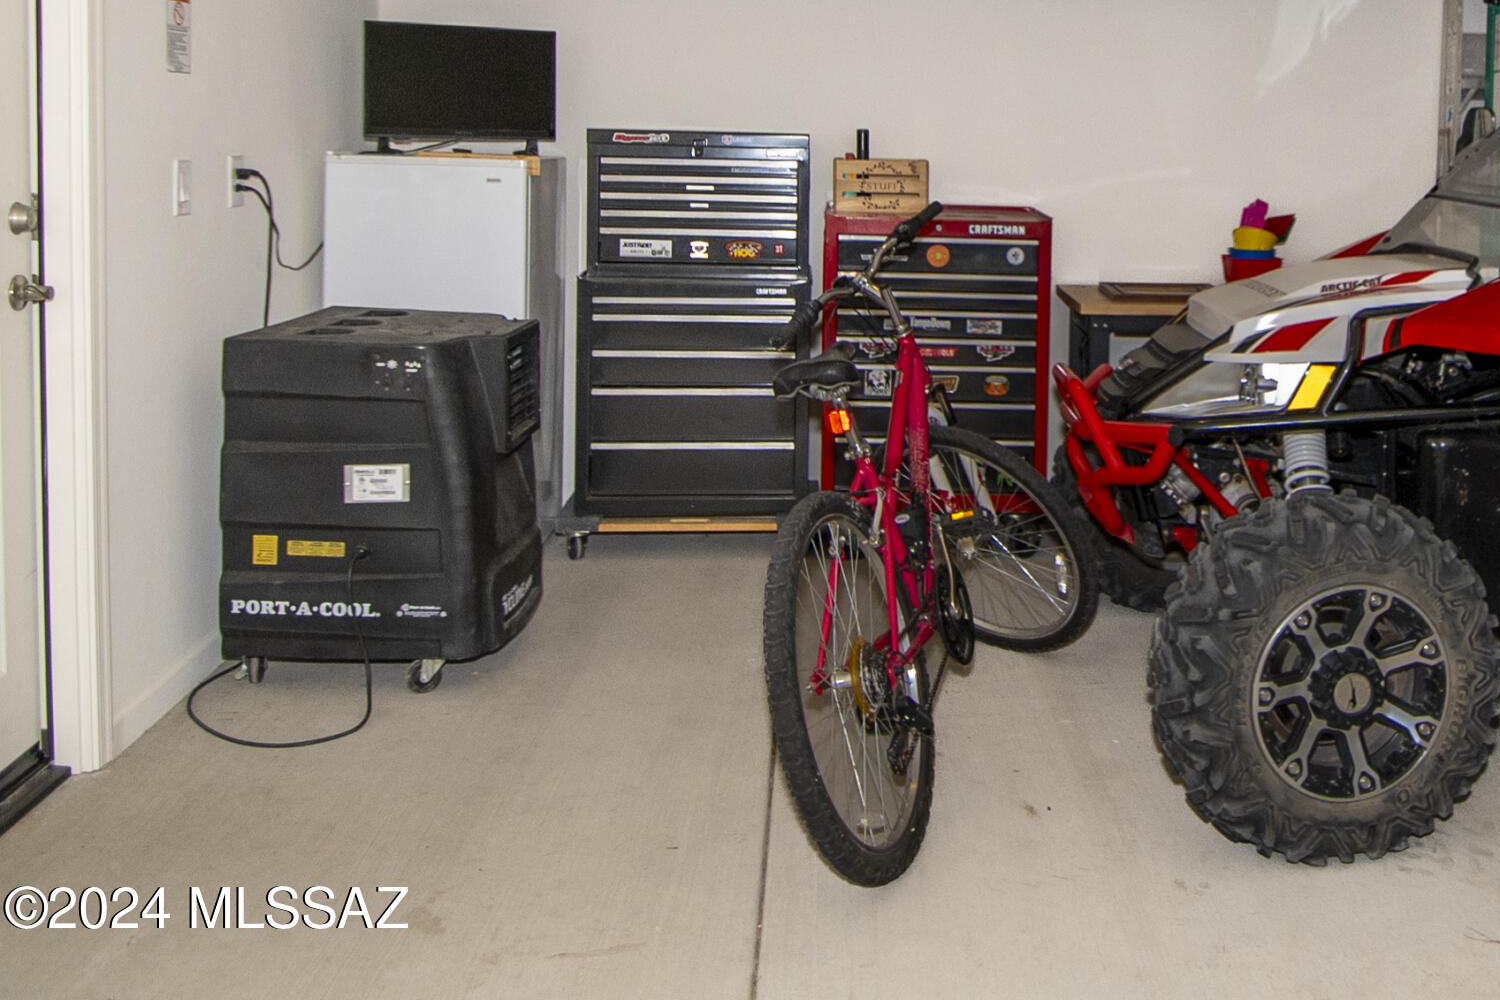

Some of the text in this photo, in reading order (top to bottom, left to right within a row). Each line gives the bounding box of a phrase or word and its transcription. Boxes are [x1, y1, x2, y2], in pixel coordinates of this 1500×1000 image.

[968, 224, 1026, 236] CRAFTSMAN
[755, 287, 788, 296] CRAFTSMAN
[1320, 280, 1358, 293] ARCTIC
